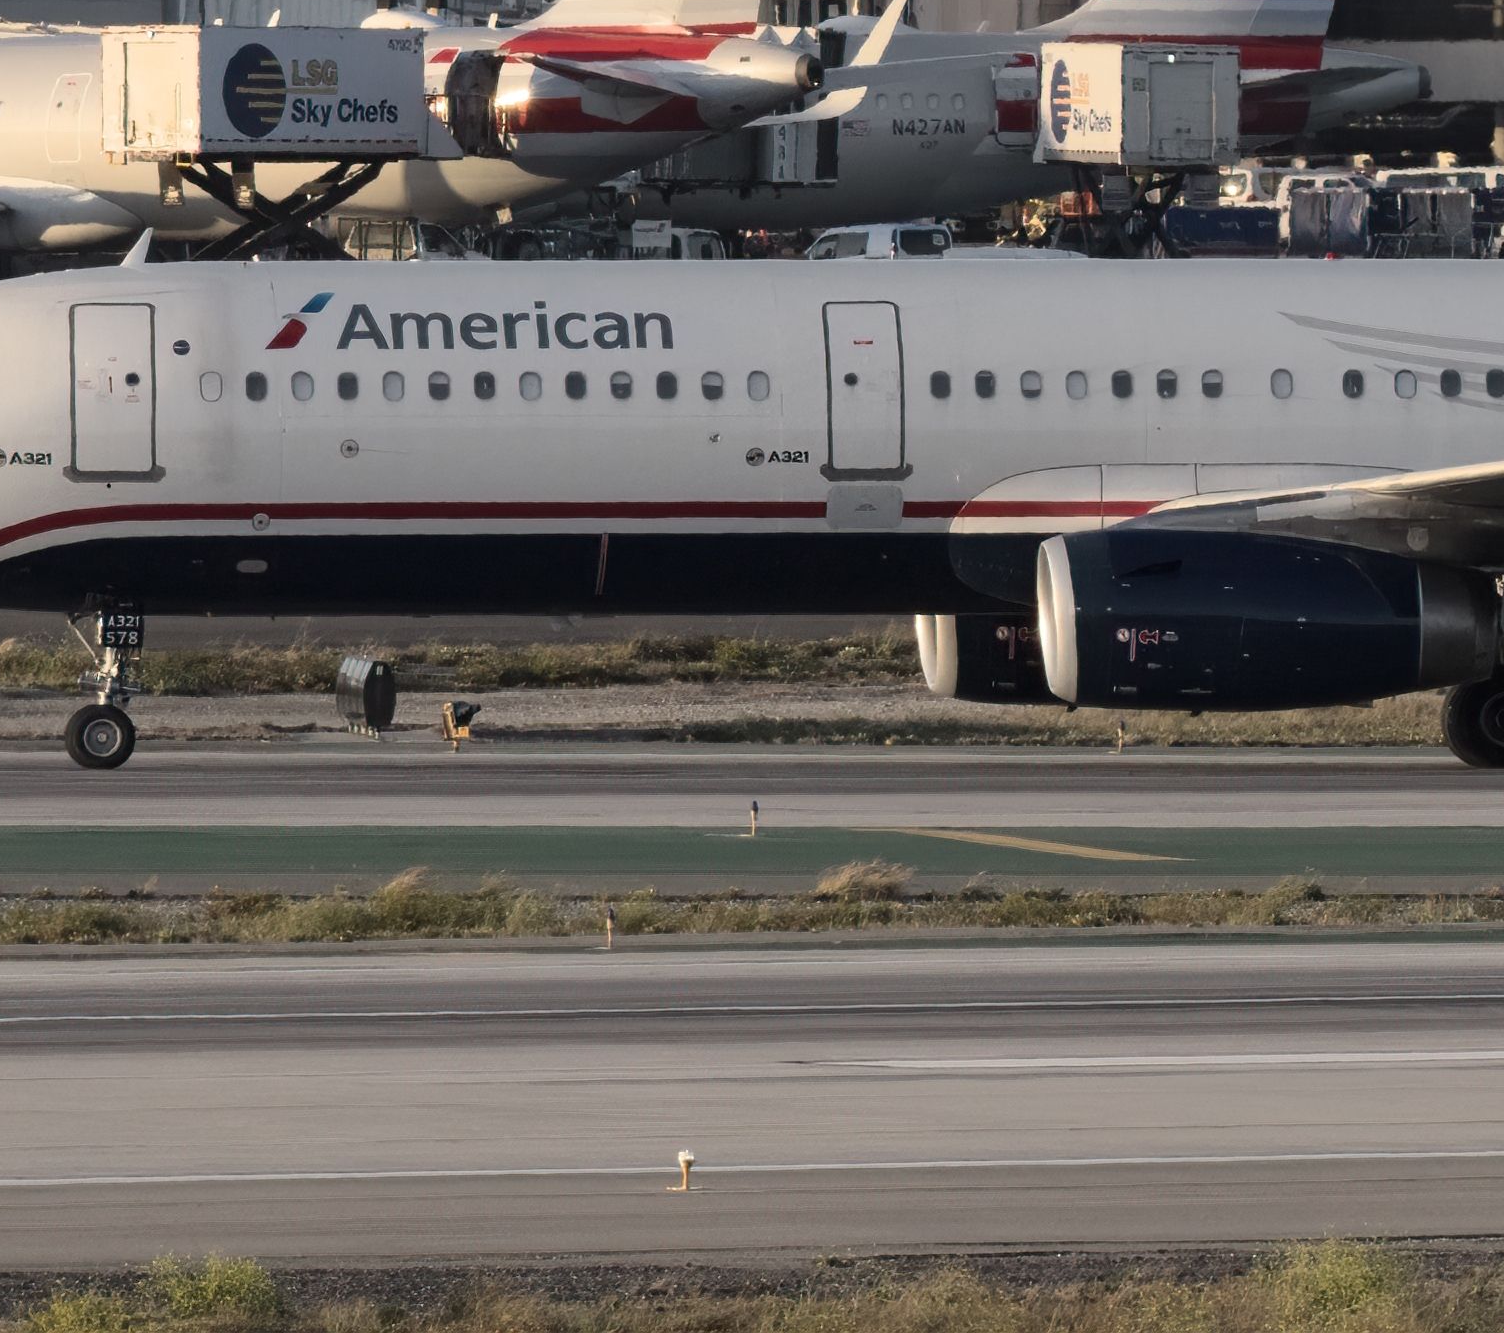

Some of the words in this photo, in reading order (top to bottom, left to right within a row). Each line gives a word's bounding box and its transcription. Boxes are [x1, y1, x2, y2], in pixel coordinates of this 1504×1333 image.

[291, 59, 338, 86] LSG
[291, 98, 332, 127] Sky
[337, 98, 398, 123] Chefs
[892, 118, 966, 136] N427AN
[336, 300, 674, 350] American
[9, 451, 52, 465] A321
[767, 450, 809, 464] A321
[107, 614, 140, 628] A321
[106, 630, 139, 645] 578
